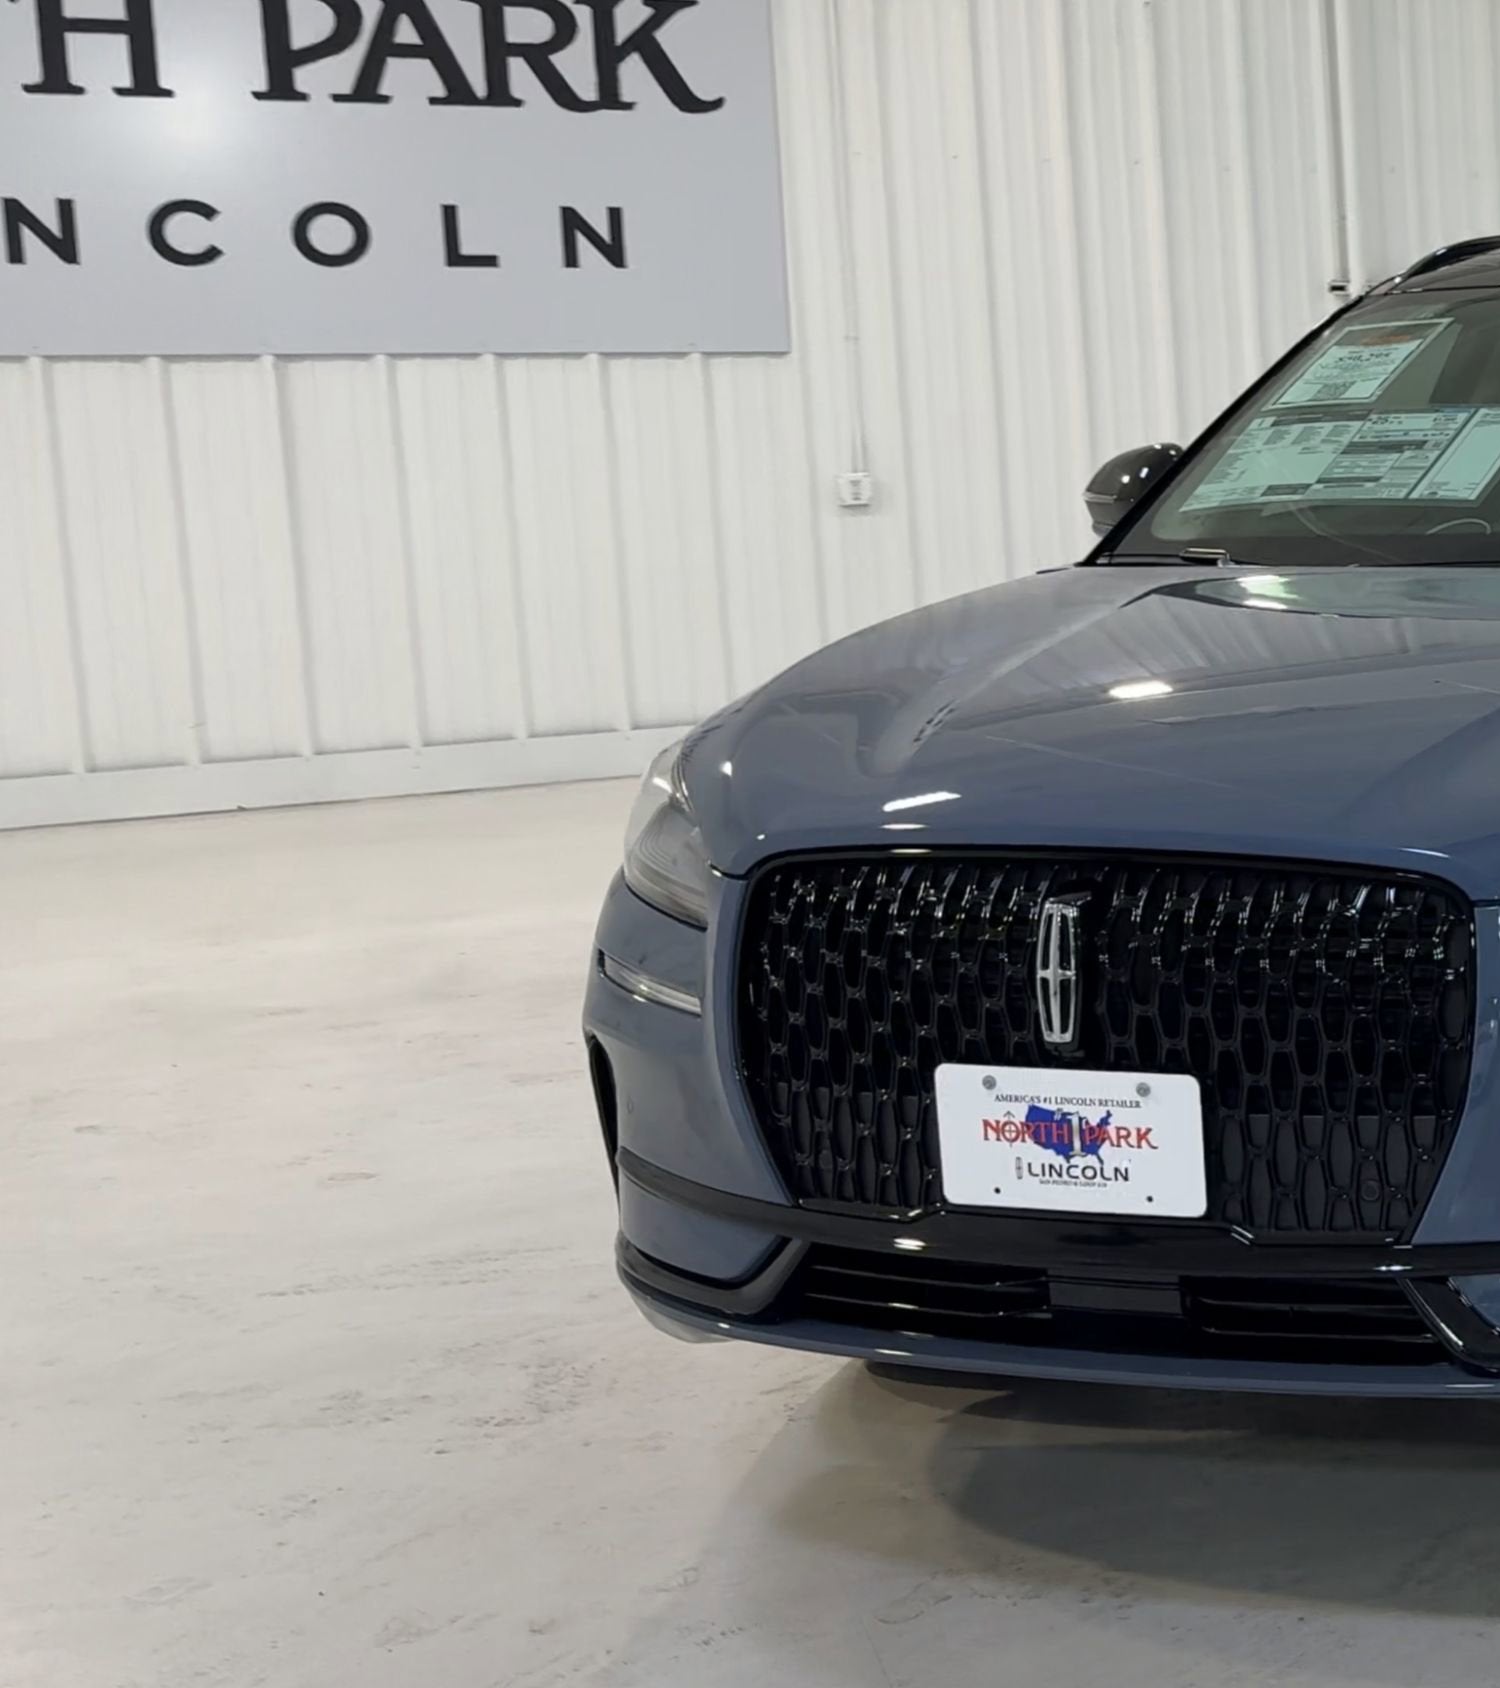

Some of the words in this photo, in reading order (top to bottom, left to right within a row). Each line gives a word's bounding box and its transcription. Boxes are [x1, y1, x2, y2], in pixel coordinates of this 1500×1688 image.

[8, 0, 174, 97] H
[251, 0, 725, 114] PARK
[0, 198, 628, 268] NCOLN
[994, 1094, 1041, 1104] AMERICA'S
[1054, 1096, 1097, 1107] LINCOLN
[1099, 1098, 1142, 1109] RETAILER
[981, 1119, 1070, 1144] NORTH
[1084, 1121, 1159, 1149] PARK
[1027, 1162, 1130, 1182] LINCOLN
